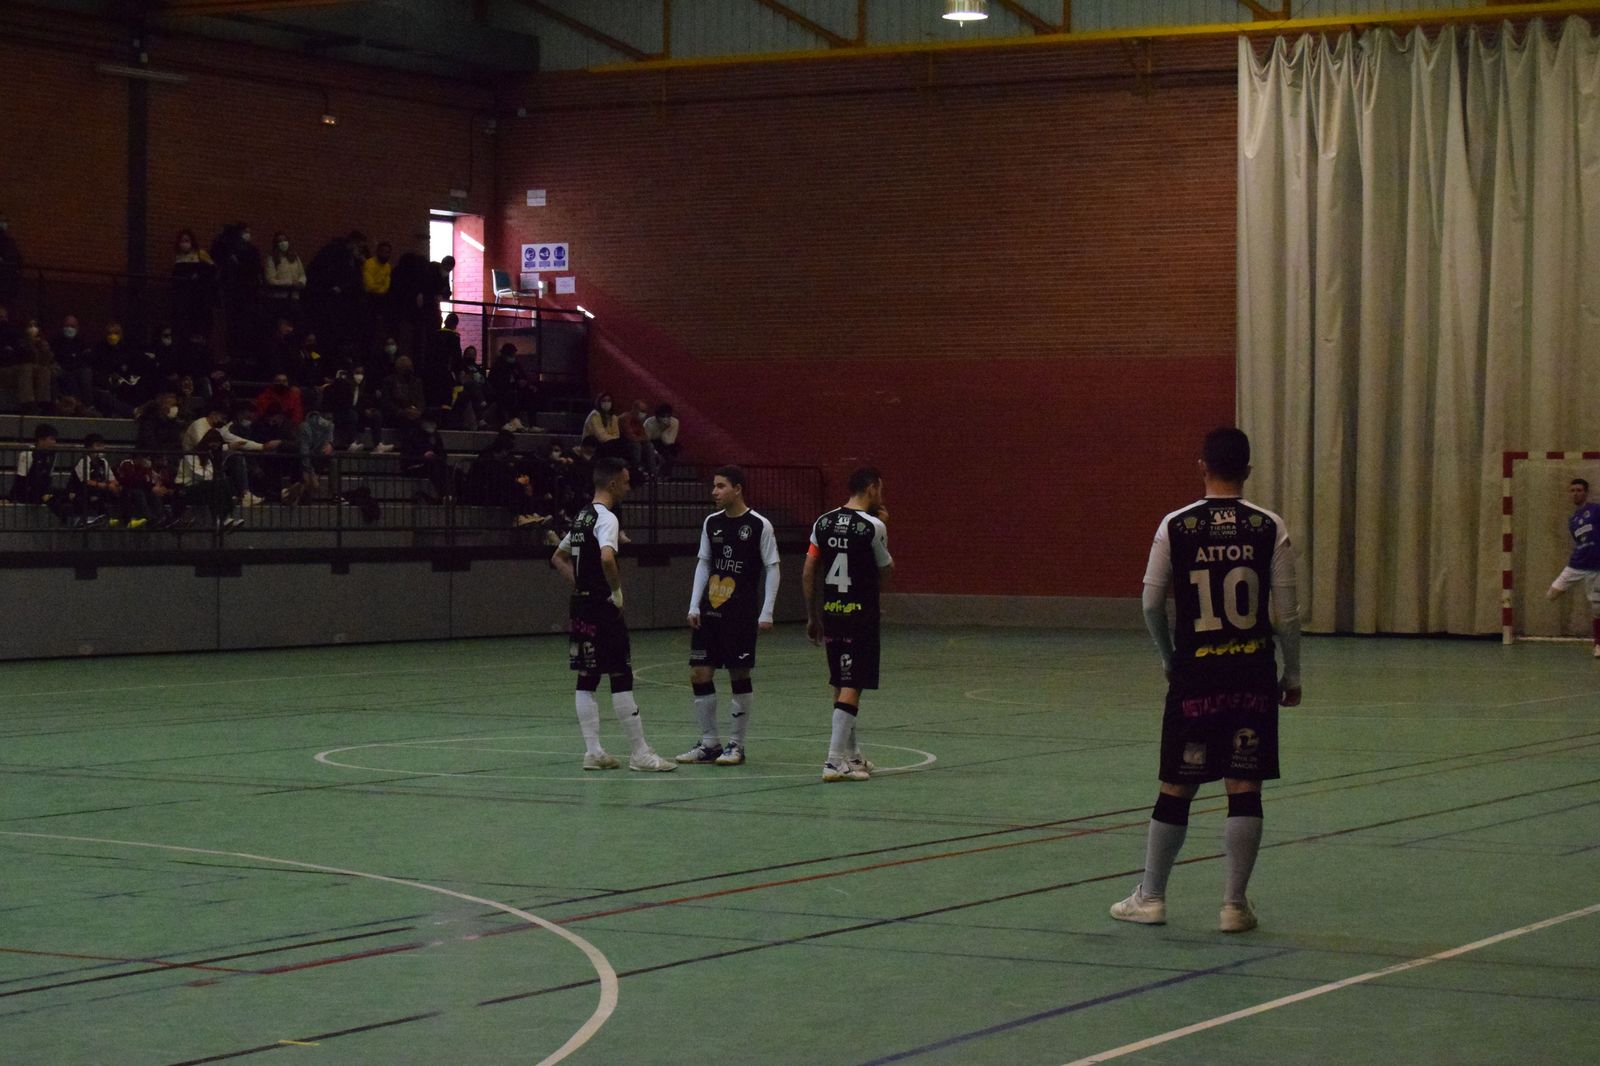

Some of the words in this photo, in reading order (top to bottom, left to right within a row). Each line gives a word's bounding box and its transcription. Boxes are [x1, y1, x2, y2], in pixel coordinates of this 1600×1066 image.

[827, 537, 849, 549] OLI
[1195, 545, 1254, 563] AITOR
[571, 546, 581, 577] 7
[825, 552, 852, 593] 4
[1189, 566, 1260, 633] 10
